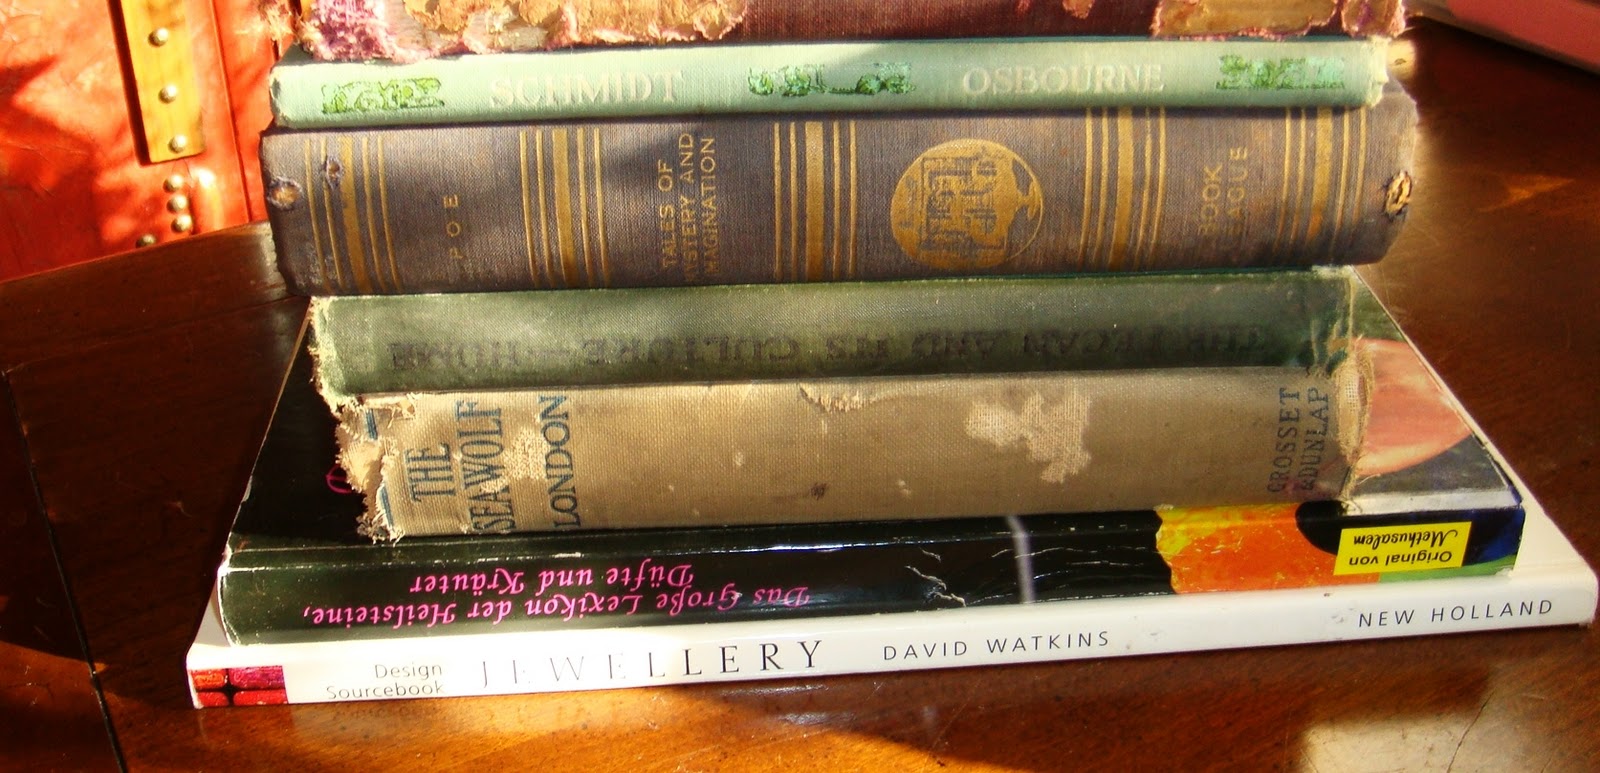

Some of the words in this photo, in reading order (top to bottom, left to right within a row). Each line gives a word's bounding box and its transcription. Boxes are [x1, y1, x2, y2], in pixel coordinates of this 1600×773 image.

[489, 69, 684, 108] SCHMIDT
[962, 64, 1165, 95] OSBOURNE
[678, 132, 695, 185] AND
[657, 158, 674, 193] OF
[443, 193, 463, 260] POE
[659, 203, 678, 269] TALES
[1266, 387, 1300, 493] GROSSET
[405, 442, 454, 503] THE
[538, 394, 582, 528] LONDON
[1353, 529, 1459, 550] Methusalem
[1349, 555, 1379, 566] von
[1385, 550, 1453, 567] Original
[409, 568, 525, 597] Kräuter
[535, 567, 593, 597] und
[606, 558, 694, 592] Düfte
[524, 594, 644, 622] Lexikon
[752, 586, 810, 607] Das
[303, 602, 456, 629] Heilsteine,
[467, 599, 512, 625] der
[1359, 609, 1415, 628] NEW
[1431, 599, 1553, 623] HOLLAND
[883, 640, 968, 661] DAVID
[986, 630, 1110, 654] WATKINS
[375, 661, 442, 680] Design
[479, 639, 824, 689] JEWELLERY
[326, 680, 445, 699] Sourcebook
